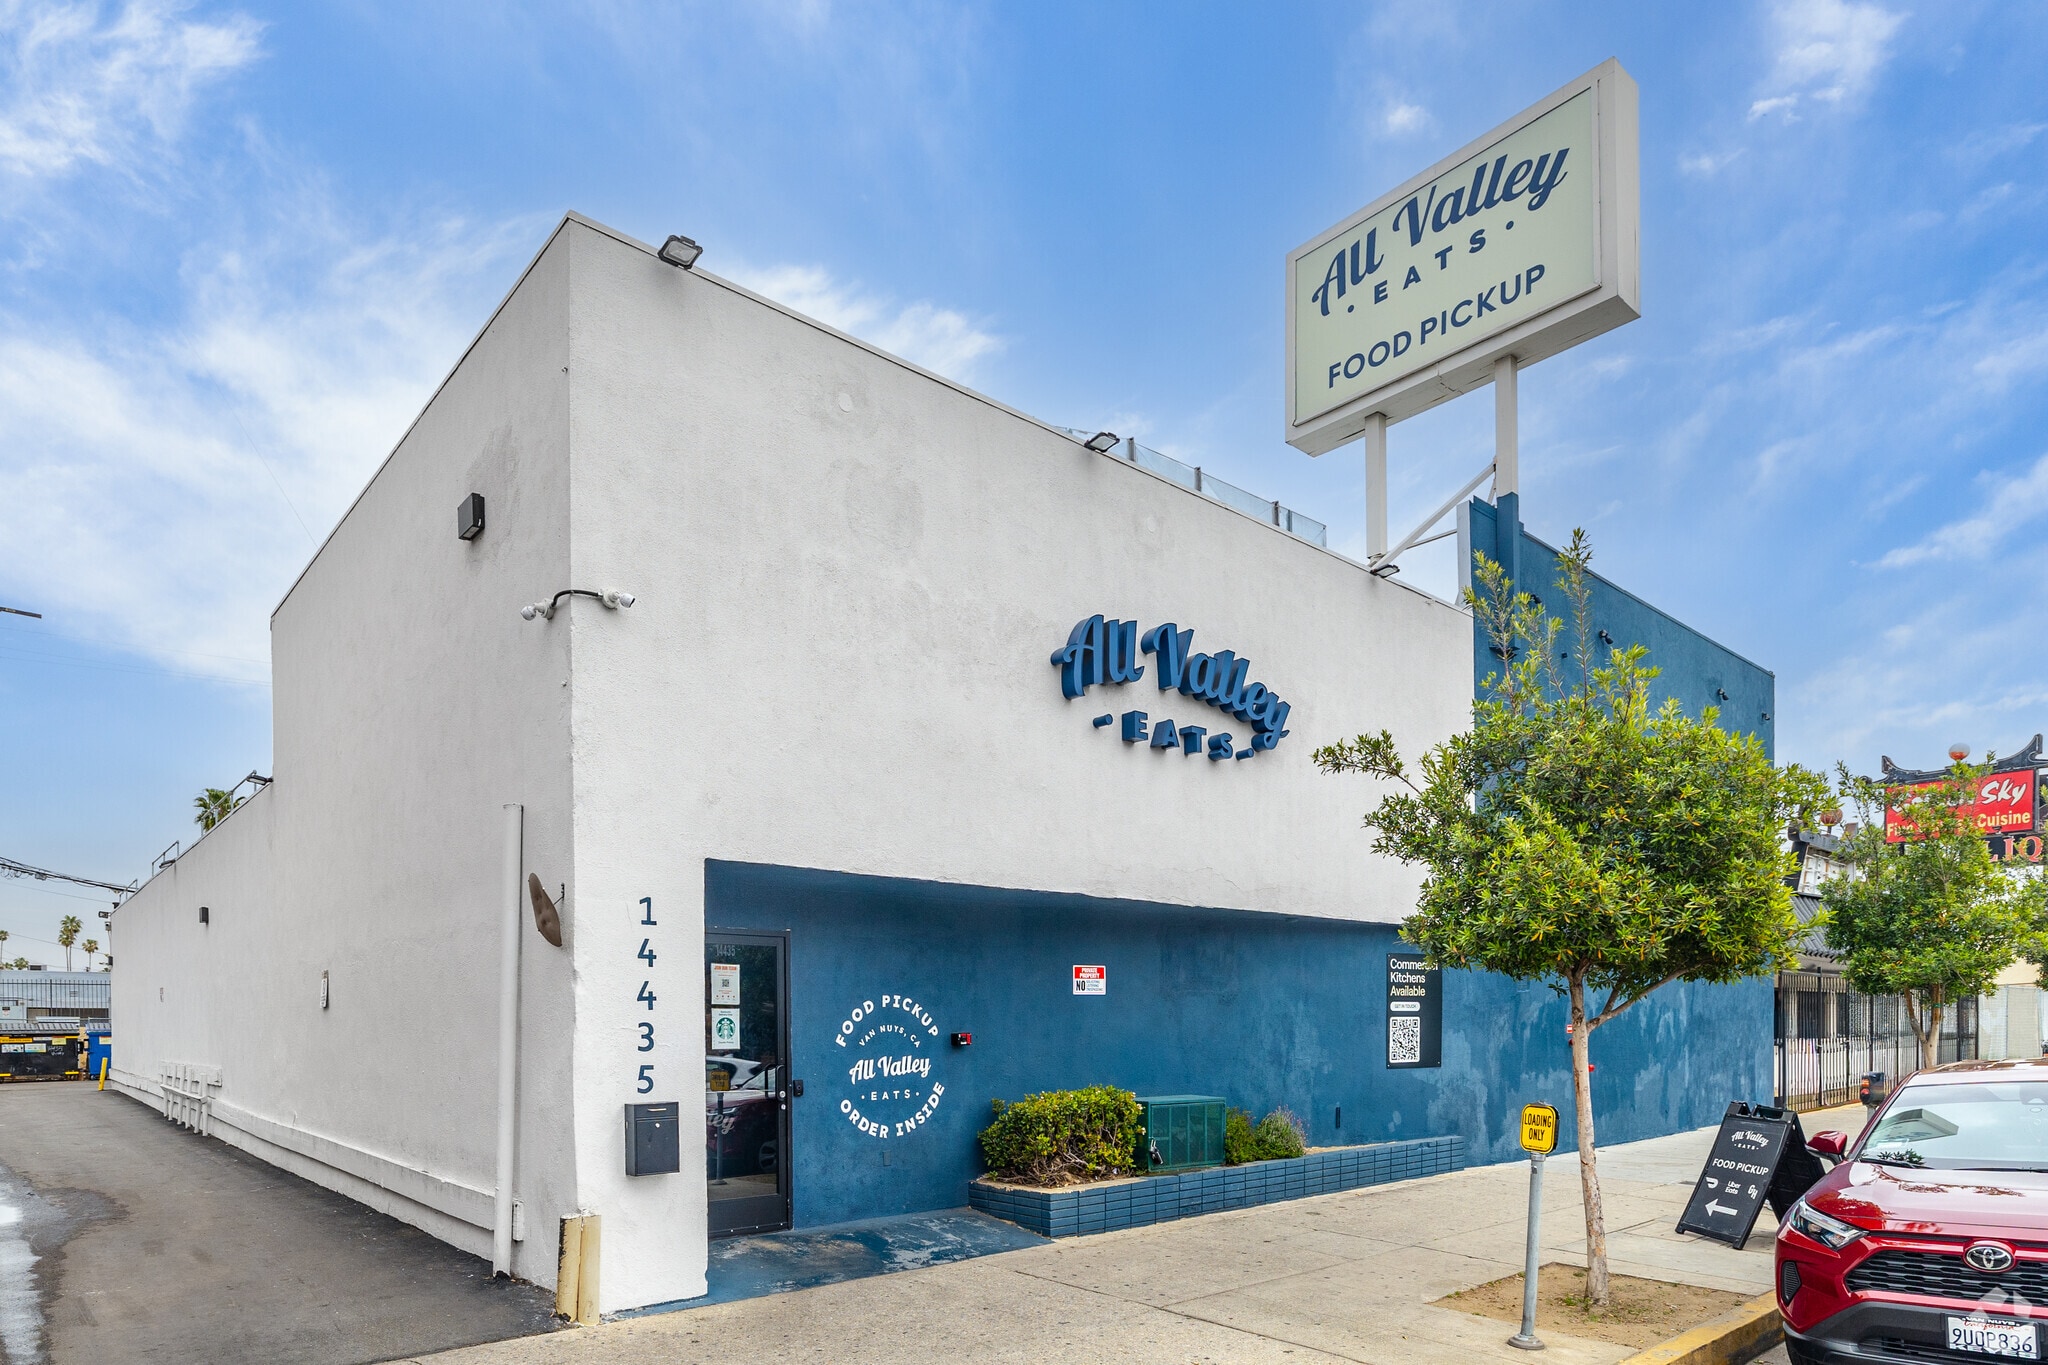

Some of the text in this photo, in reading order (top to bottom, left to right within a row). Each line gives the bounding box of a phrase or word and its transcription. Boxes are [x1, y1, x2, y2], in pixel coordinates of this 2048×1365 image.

[1312, 147, 1570, 316] All Valley
[1374, 228, 1487, 304] EATS
[1328, 263, 1546, 388] FOOD PICKUP
[1050, 614, 1291, 752] All Valley
[1121, 710, 1234, 762] EATS
[1981, 778, 2027, 806] Sky
[1977, 811, 2031, 828] Cuisine
[1075, 980, 1086, 991] NO
[1390, 972, 1426, 983] Kitchens
[1390, 985, 1426, 996] Available
[835, 995, 939, 1047] FOOD PICKUP
[859, 1024, 921, 1048] VAN NUYS, CA
[849, 1055, 932, 1085] All Valley
[870, 1089, 911, 1101] EATS
[840, 1081, 945, 1139] ORDER INSIDE
[1524, 1113, 1552, 1128] LOADING
[1528, 1128, 1545, 1141] ONLY
[1731, 1130, 1770, 1147] All Valley
[1712, 1158, 1770, 1176] FOOD PICKUP
[1725, 1187, 1739, 1195] Eats
